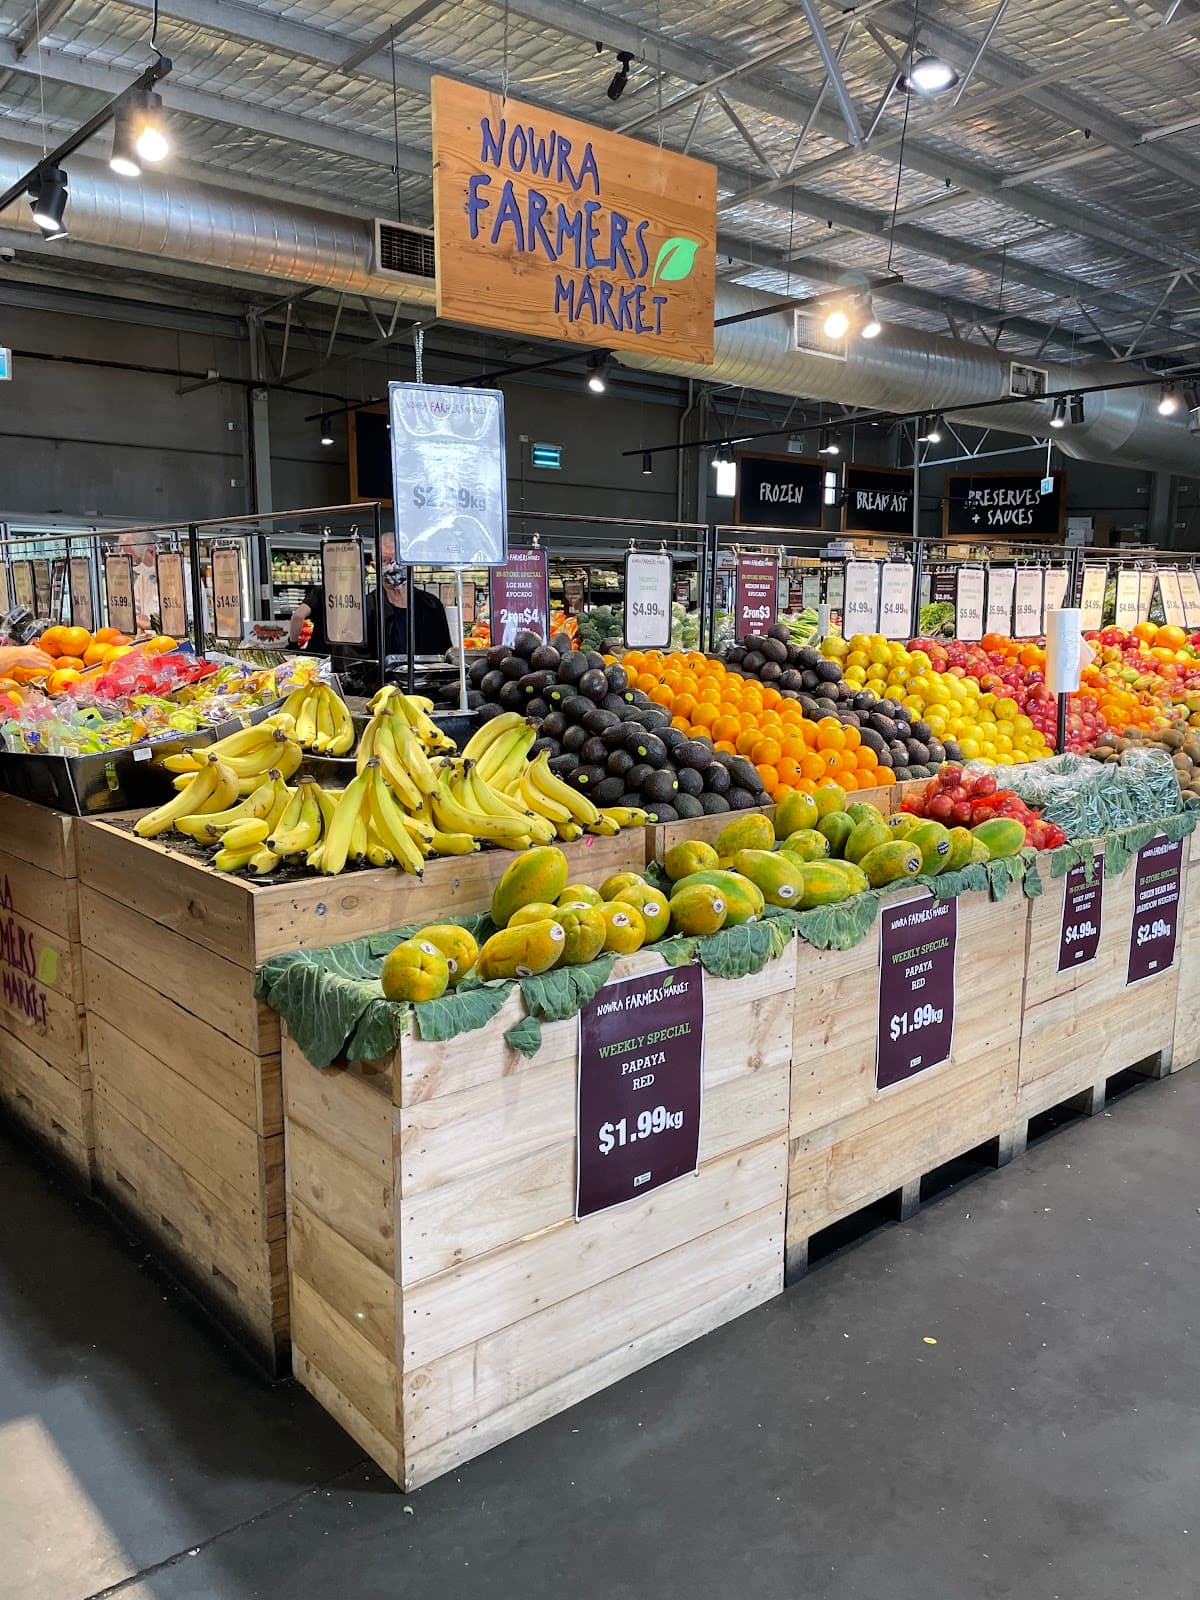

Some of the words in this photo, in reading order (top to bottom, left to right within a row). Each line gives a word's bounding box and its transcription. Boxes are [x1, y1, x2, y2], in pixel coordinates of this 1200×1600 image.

[481, 117, 599, 195] NOWRA
[468, 174, 650, 279] FARMERS
[555, 274, 667, 335] MARKET
[759, 482, 803, 504] FROZEN
[857, 491, 908, 512] BREAKAST
[968, 489, 1041, 507] PRESERVES
[987, 508, 1034, 526] SAUCES
[632, 601, 664, 617] $4.99kg
[908, 908, 933, 927] FARMERS
[1137, 918, 1171, 947] $2.99kg
[891, 946, 921, 965] WEEKLY
[921, 937, 950, 956] SPECIAL
[904, 960, 933, 979] PAPAYA
[911, 977, 926, 991] RED
[597, 1000, 625, 1017] NOWRA
[625, 988, 663, 1011] FARMERS
[663, 981, 690, 999] MARKET
[890, 1003, 944, 1042] $1.99kg
[598, 1036, 645, 1059] WEEKLY
[647, 1022, 691, 1046] SPECIAL
[620, 1051, 667, 1076] PAPAYA
[633, 1073, 658, 1091] RED
[598, 1105, 684, 1156] $1.99kg
